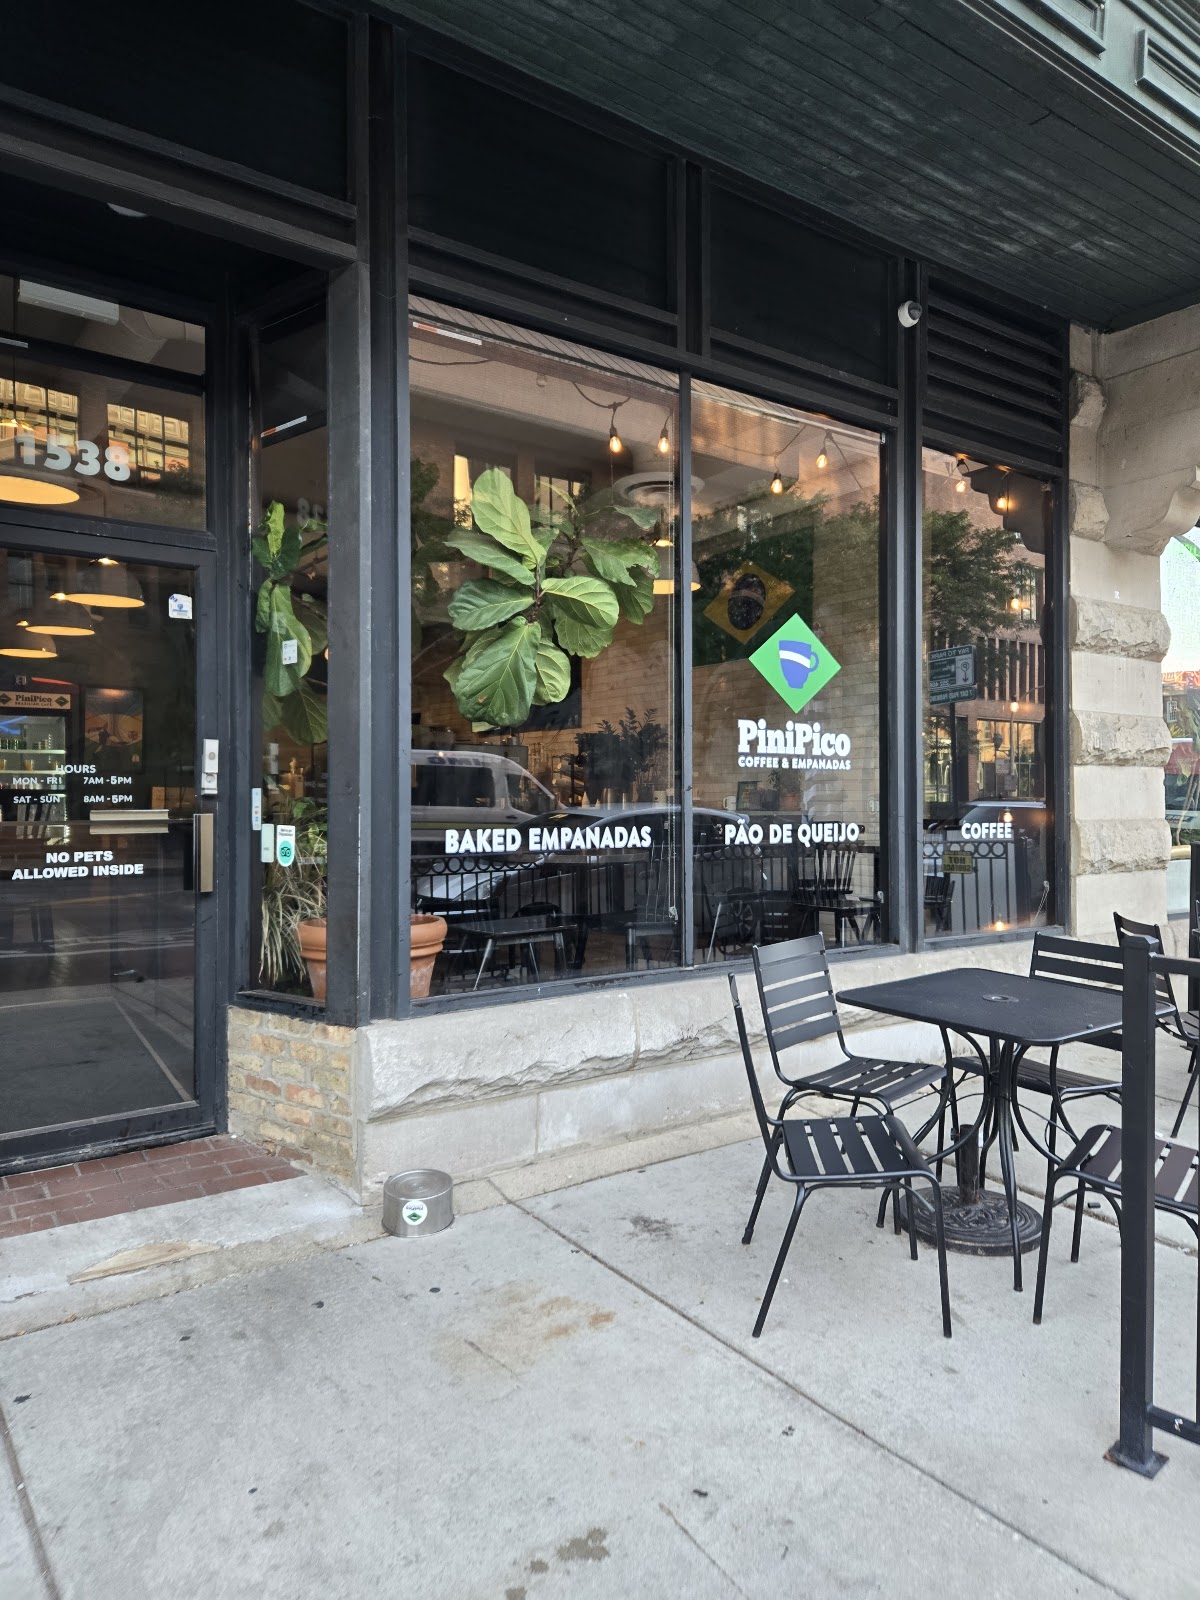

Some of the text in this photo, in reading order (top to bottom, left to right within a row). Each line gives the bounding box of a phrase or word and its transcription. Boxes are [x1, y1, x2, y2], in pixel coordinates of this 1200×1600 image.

[15, 432, 131, 481] 1538
[15, 694, 53, 703] PiniPico
[737, 718, 851, 757] PiniPico
[55, 764, 97, 774] HOURS
[737, 755, 852, 771] COFFEE & EMPANADAS
[12, 777, 38, 785] MON
[47, 776, 62, 785] FRI
[83, 776, 104, 785] 7AM
[13, 795, 32, 804] SAT
[39, 795, 61, 804] SUN
[83, 795, 105, 803] 8AM
[724, 818, 860, 847] PÃO DE QUEIJO
[961, 822, 1012, 840] COFFEE
[445, 825, 652, 854] BAKED EMPANADAS
[46, 850, 114, 864] NO PETS
[11, 863, 144, 880] ALLOWED INSIDE
